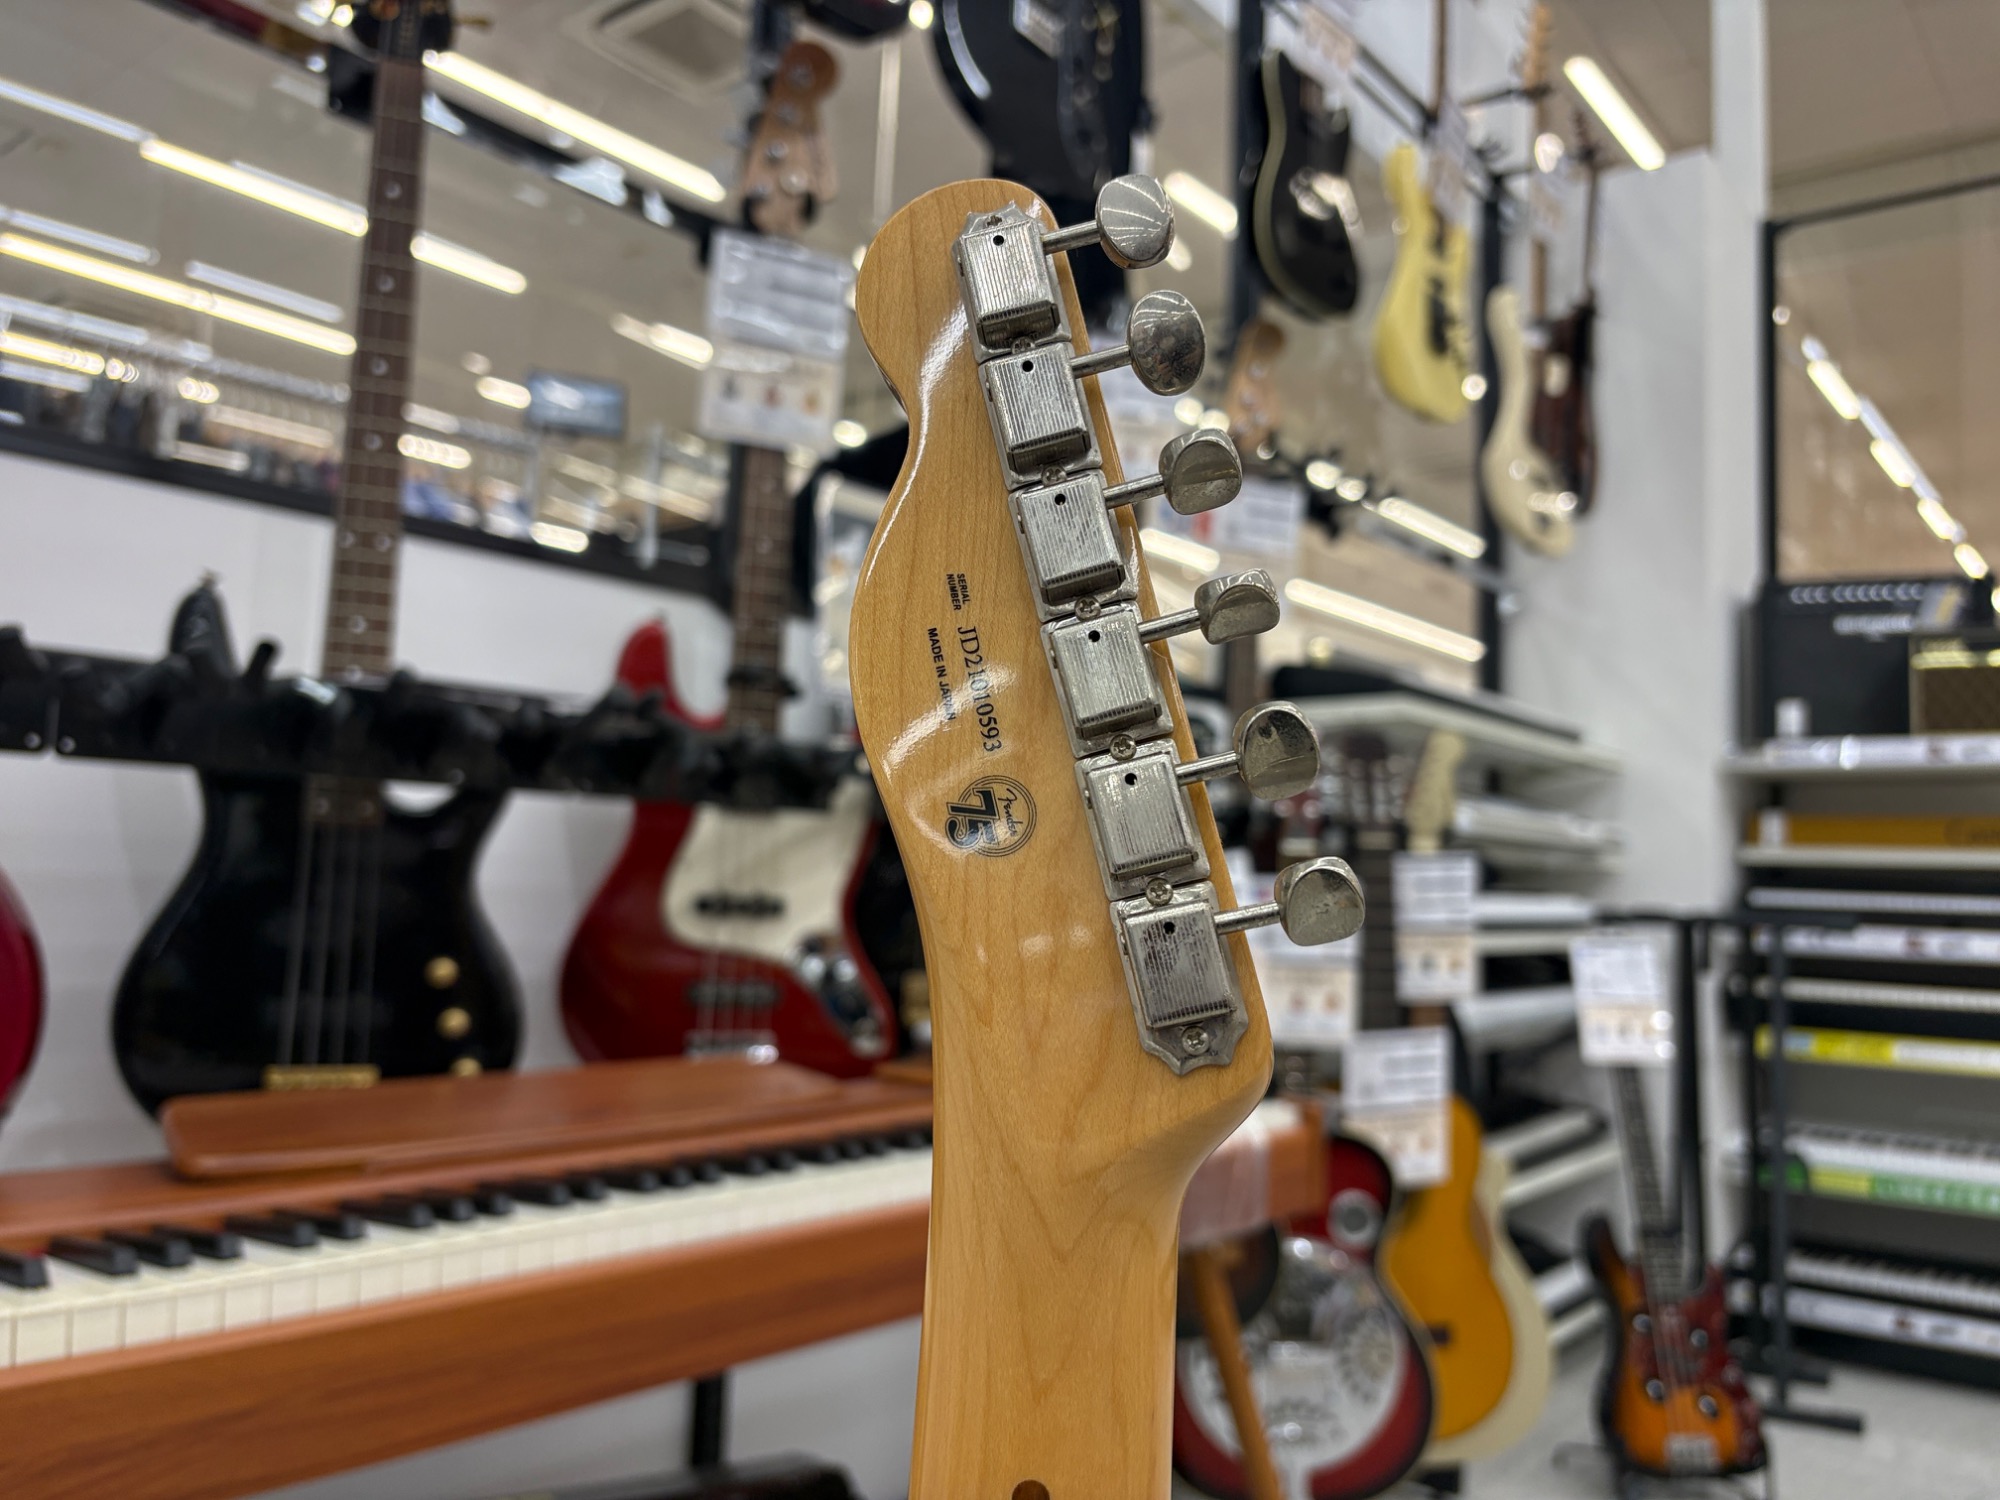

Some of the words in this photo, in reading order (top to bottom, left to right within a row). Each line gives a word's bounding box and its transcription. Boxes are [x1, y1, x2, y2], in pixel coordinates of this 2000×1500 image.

[946, 573, 962, 611] NUMBER
[957, 573, 970, 605] SERIAL
[927, 627, 944, 663] MADE
[936, 664, 947, 678] IN
[957, 626, 1002, 751] JD21010593
[945, 786, 1001, 848] 75
[998, 788, 1023, 836] Fender
